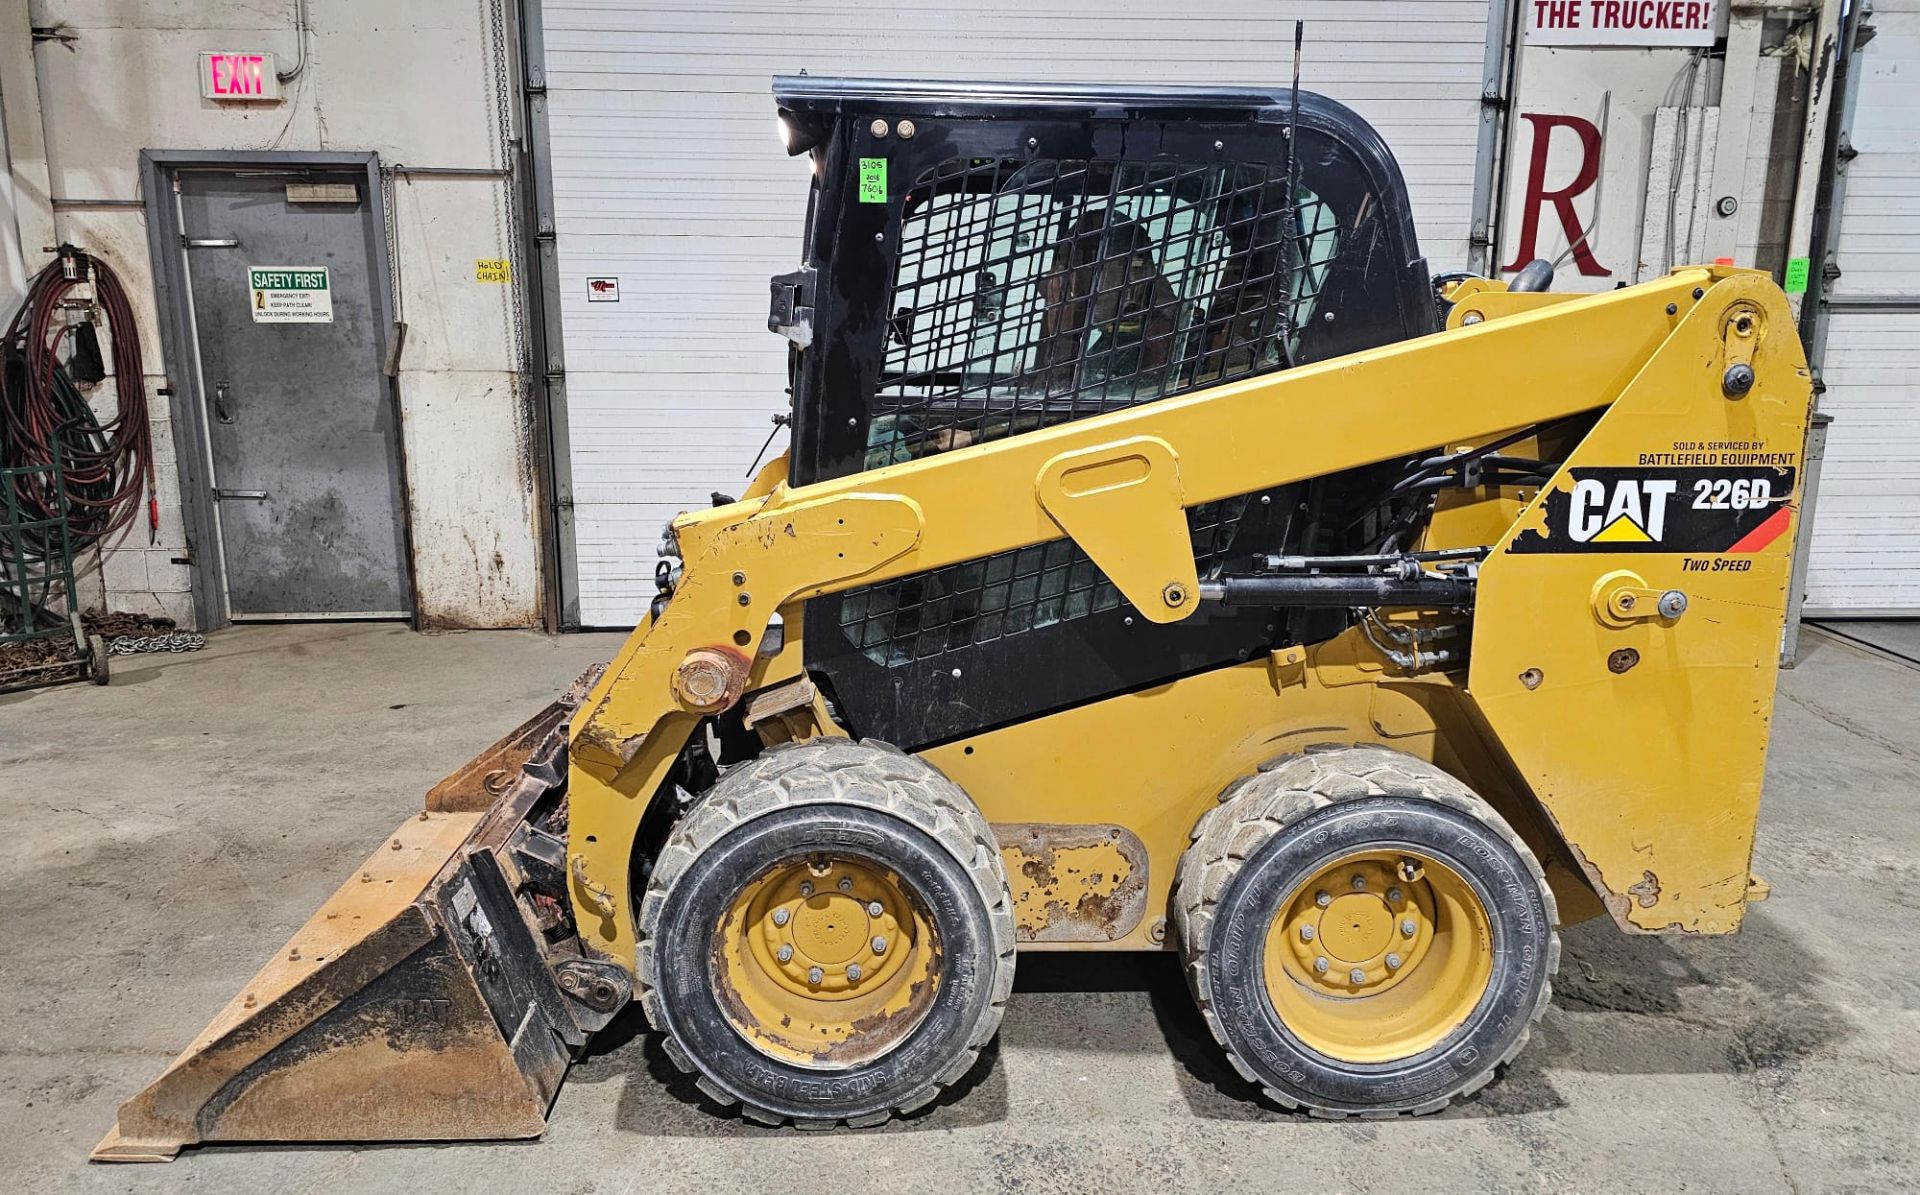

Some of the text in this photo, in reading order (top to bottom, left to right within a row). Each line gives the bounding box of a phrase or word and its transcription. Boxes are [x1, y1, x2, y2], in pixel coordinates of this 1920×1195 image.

[1535, 1, 1710, 30] THE TRUCKER!
[211, 55, 263, 95] EXIT
[1502, 113, 1612, 277] R
[254, 273, 323, 288] SAFETY FIRST
[256, 291, 265, 309] 2
[1639, 453, 1796, 466] BATTLEFIELD EQUIPMENT
[1672, 442, 1764, 450] SOLD & SERVICED BY
[1568, 479, 1771, 542] CAT 226D
[1458, 835, 1533, 935] BOSSMAN
[396, 998, 450, 1028] CAT
[1229, 986, 1305, 1082] BOSSMAN
